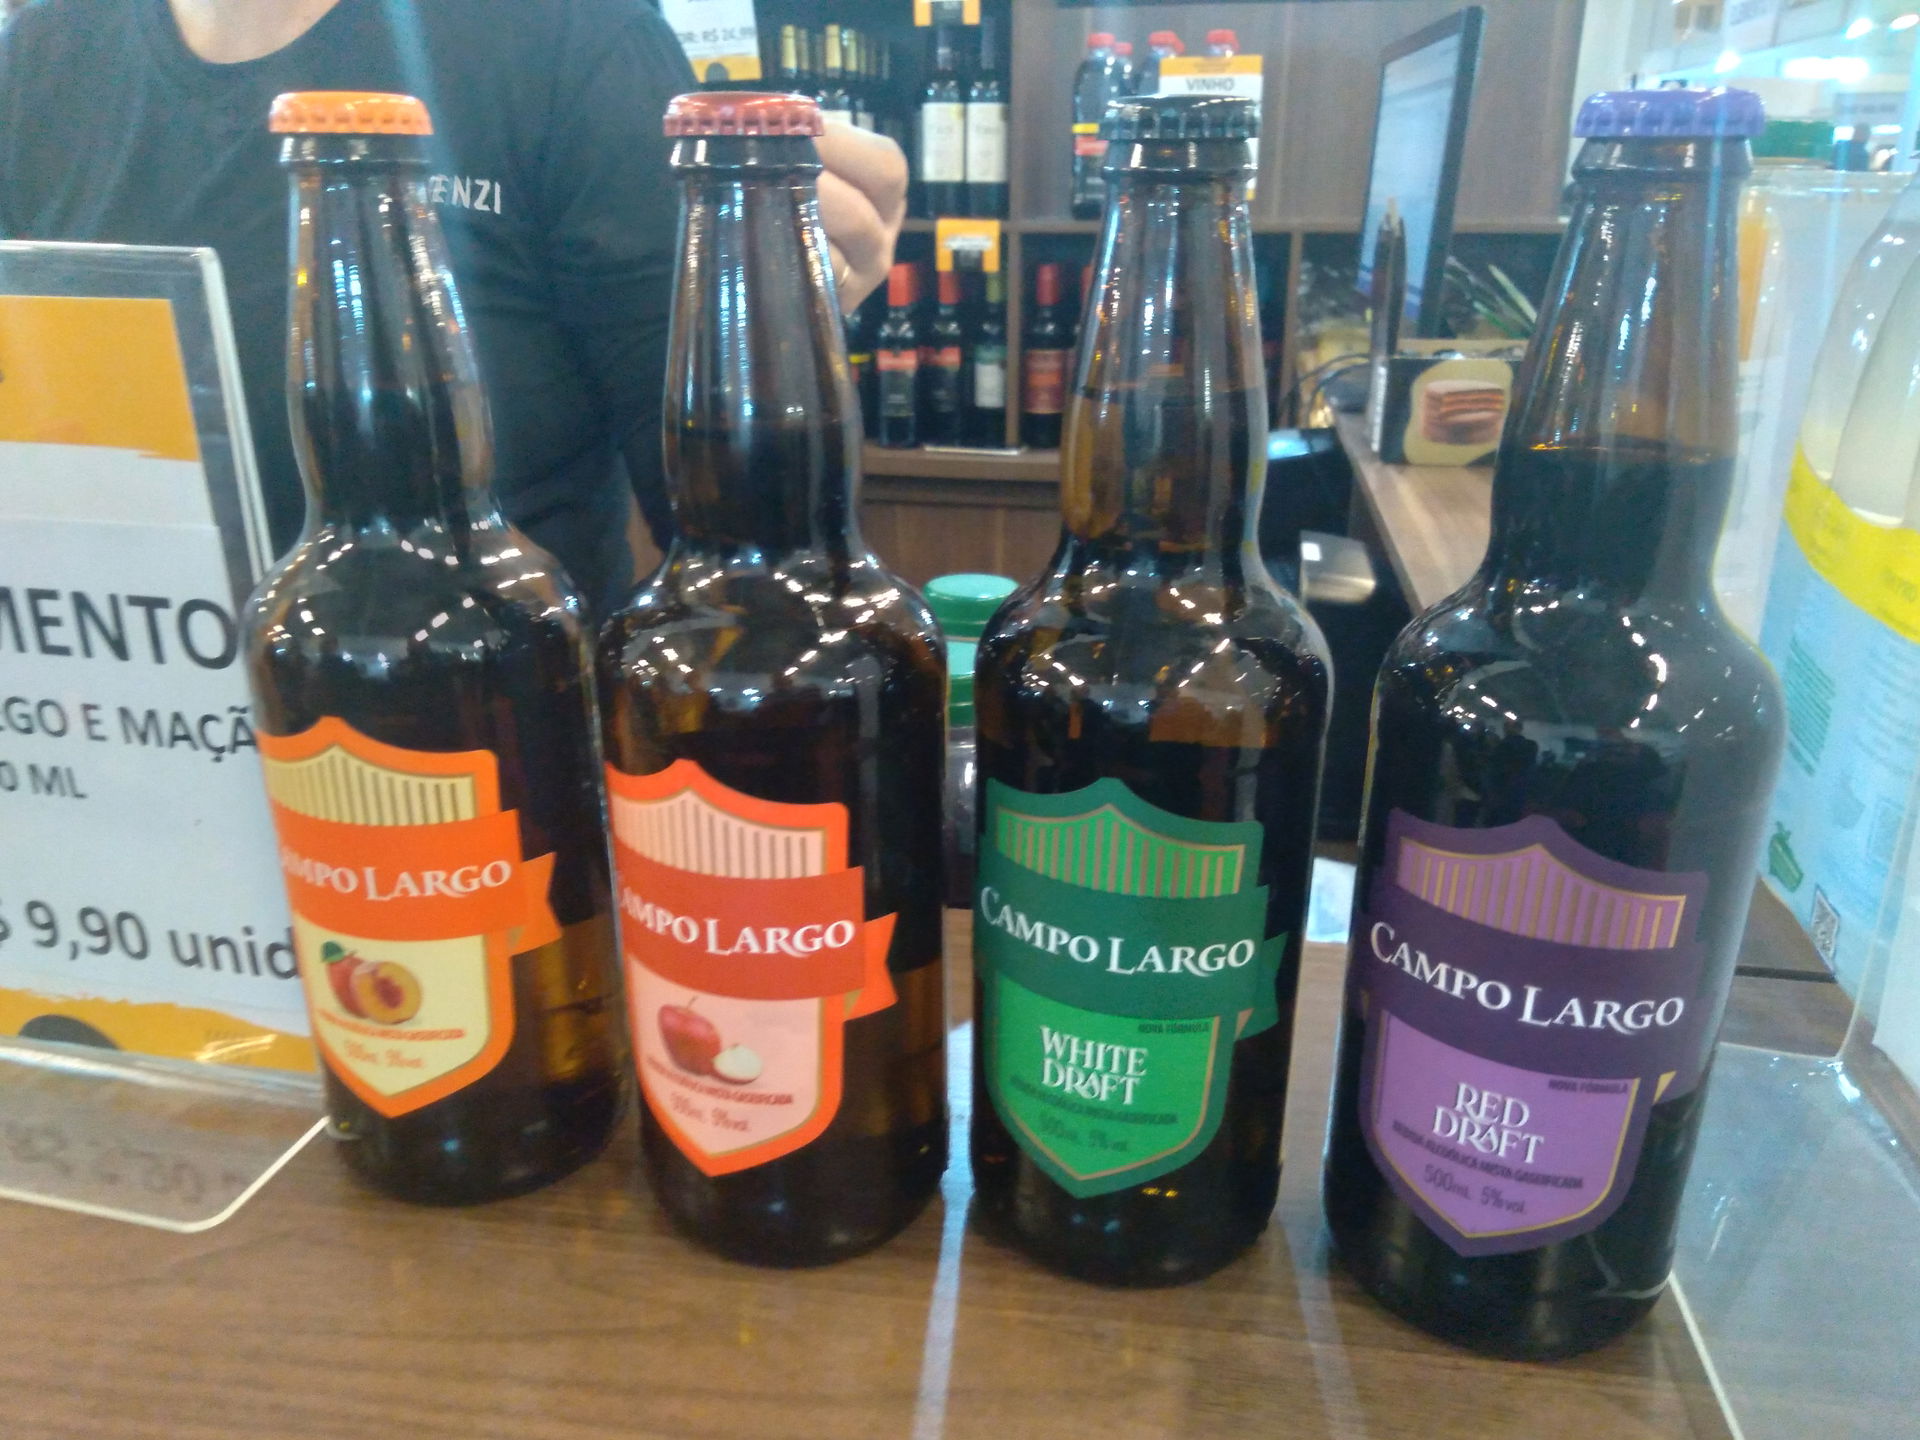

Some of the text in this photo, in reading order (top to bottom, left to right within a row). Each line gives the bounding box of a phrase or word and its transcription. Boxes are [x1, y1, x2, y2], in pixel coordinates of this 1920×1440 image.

[1185, 76, 1235, 92] VINHO
[81, 703, 108, 743] E
[28, 764, 88, 799] ML
[363, 860, 512, 901] LARGO
[25, 900, 149, 961] 9,90
[704, 917, 855, 958] LARGO
[980, 886, 1256, 977] CAMPO LARGO
[1370, 921, 1685, 1036] CAMPO LARGO
[1039, 1024, 1149, 1077] WHITE
[1041, 1056, 1141, 1106] DRAFT
[1453, 1082, 1531, 1129] RED
[1431, 1106, 1546, 1165] DRAFT
